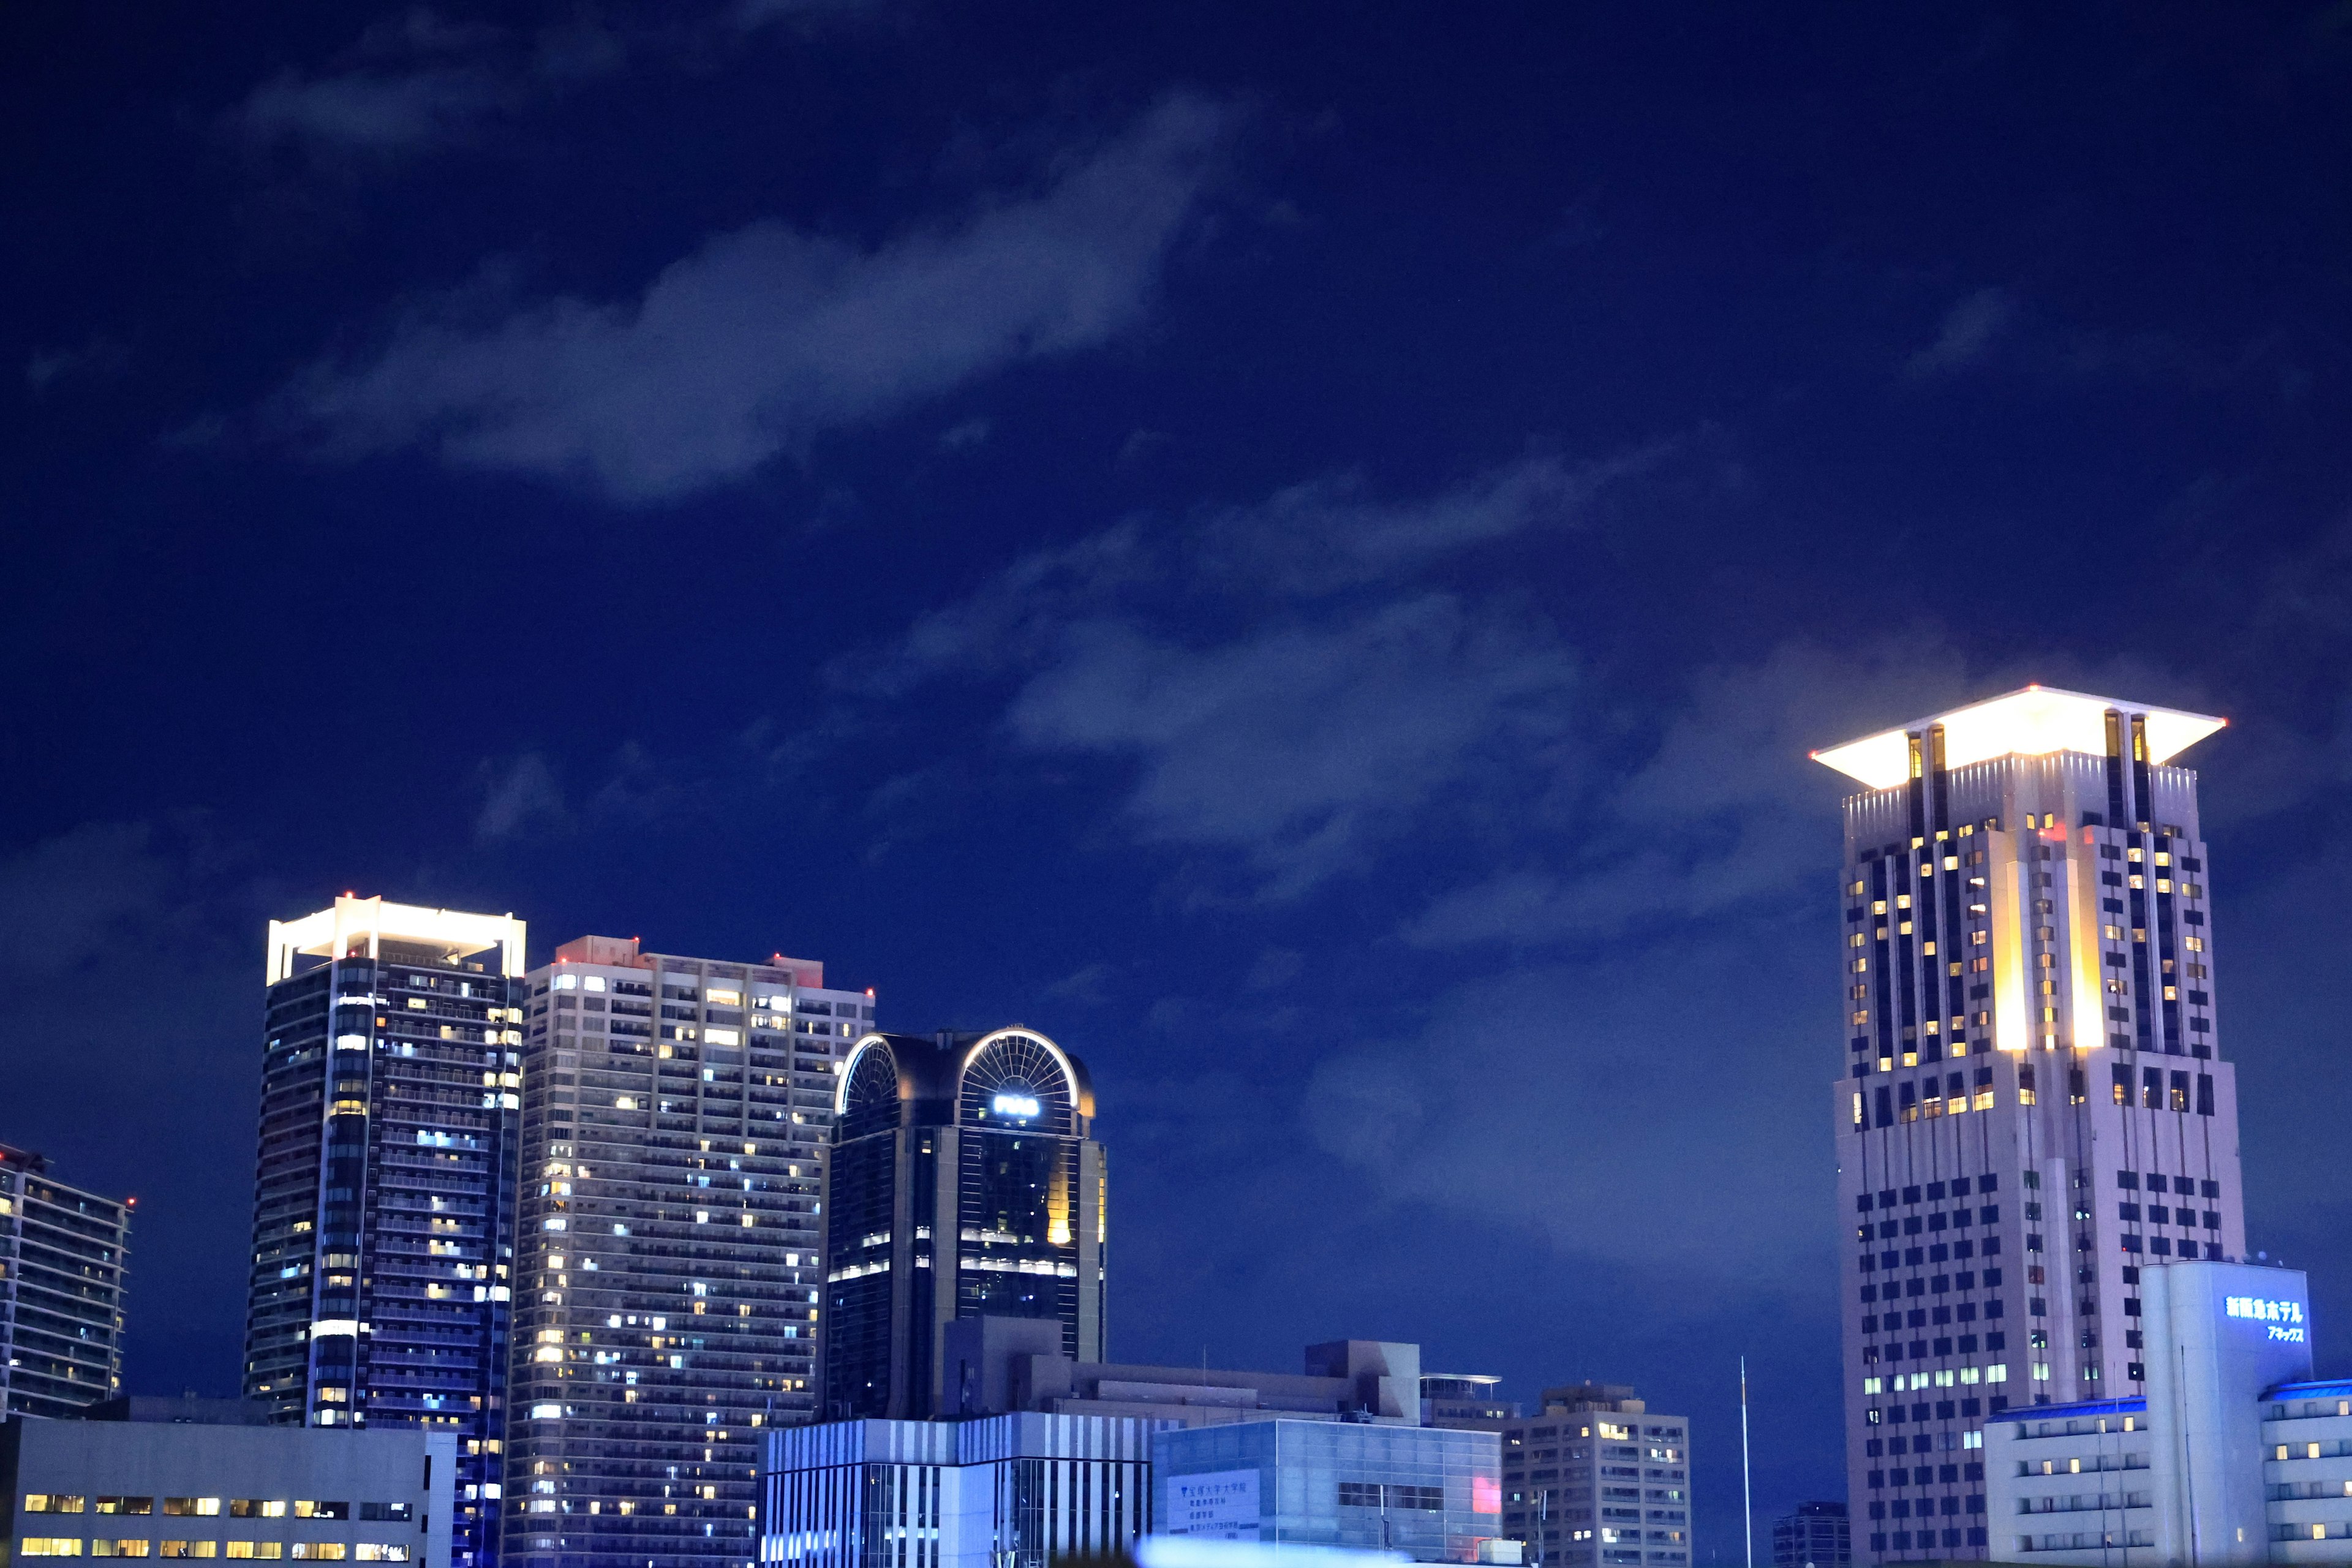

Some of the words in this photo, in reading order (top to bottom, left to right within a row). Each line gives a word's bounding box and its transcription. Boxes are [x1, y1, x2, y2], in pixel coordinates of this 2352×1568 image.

[2226, 1296, 2303, 1323] 新阪急ホテル
[2267, 1325, 2304, 1342] アネックス
